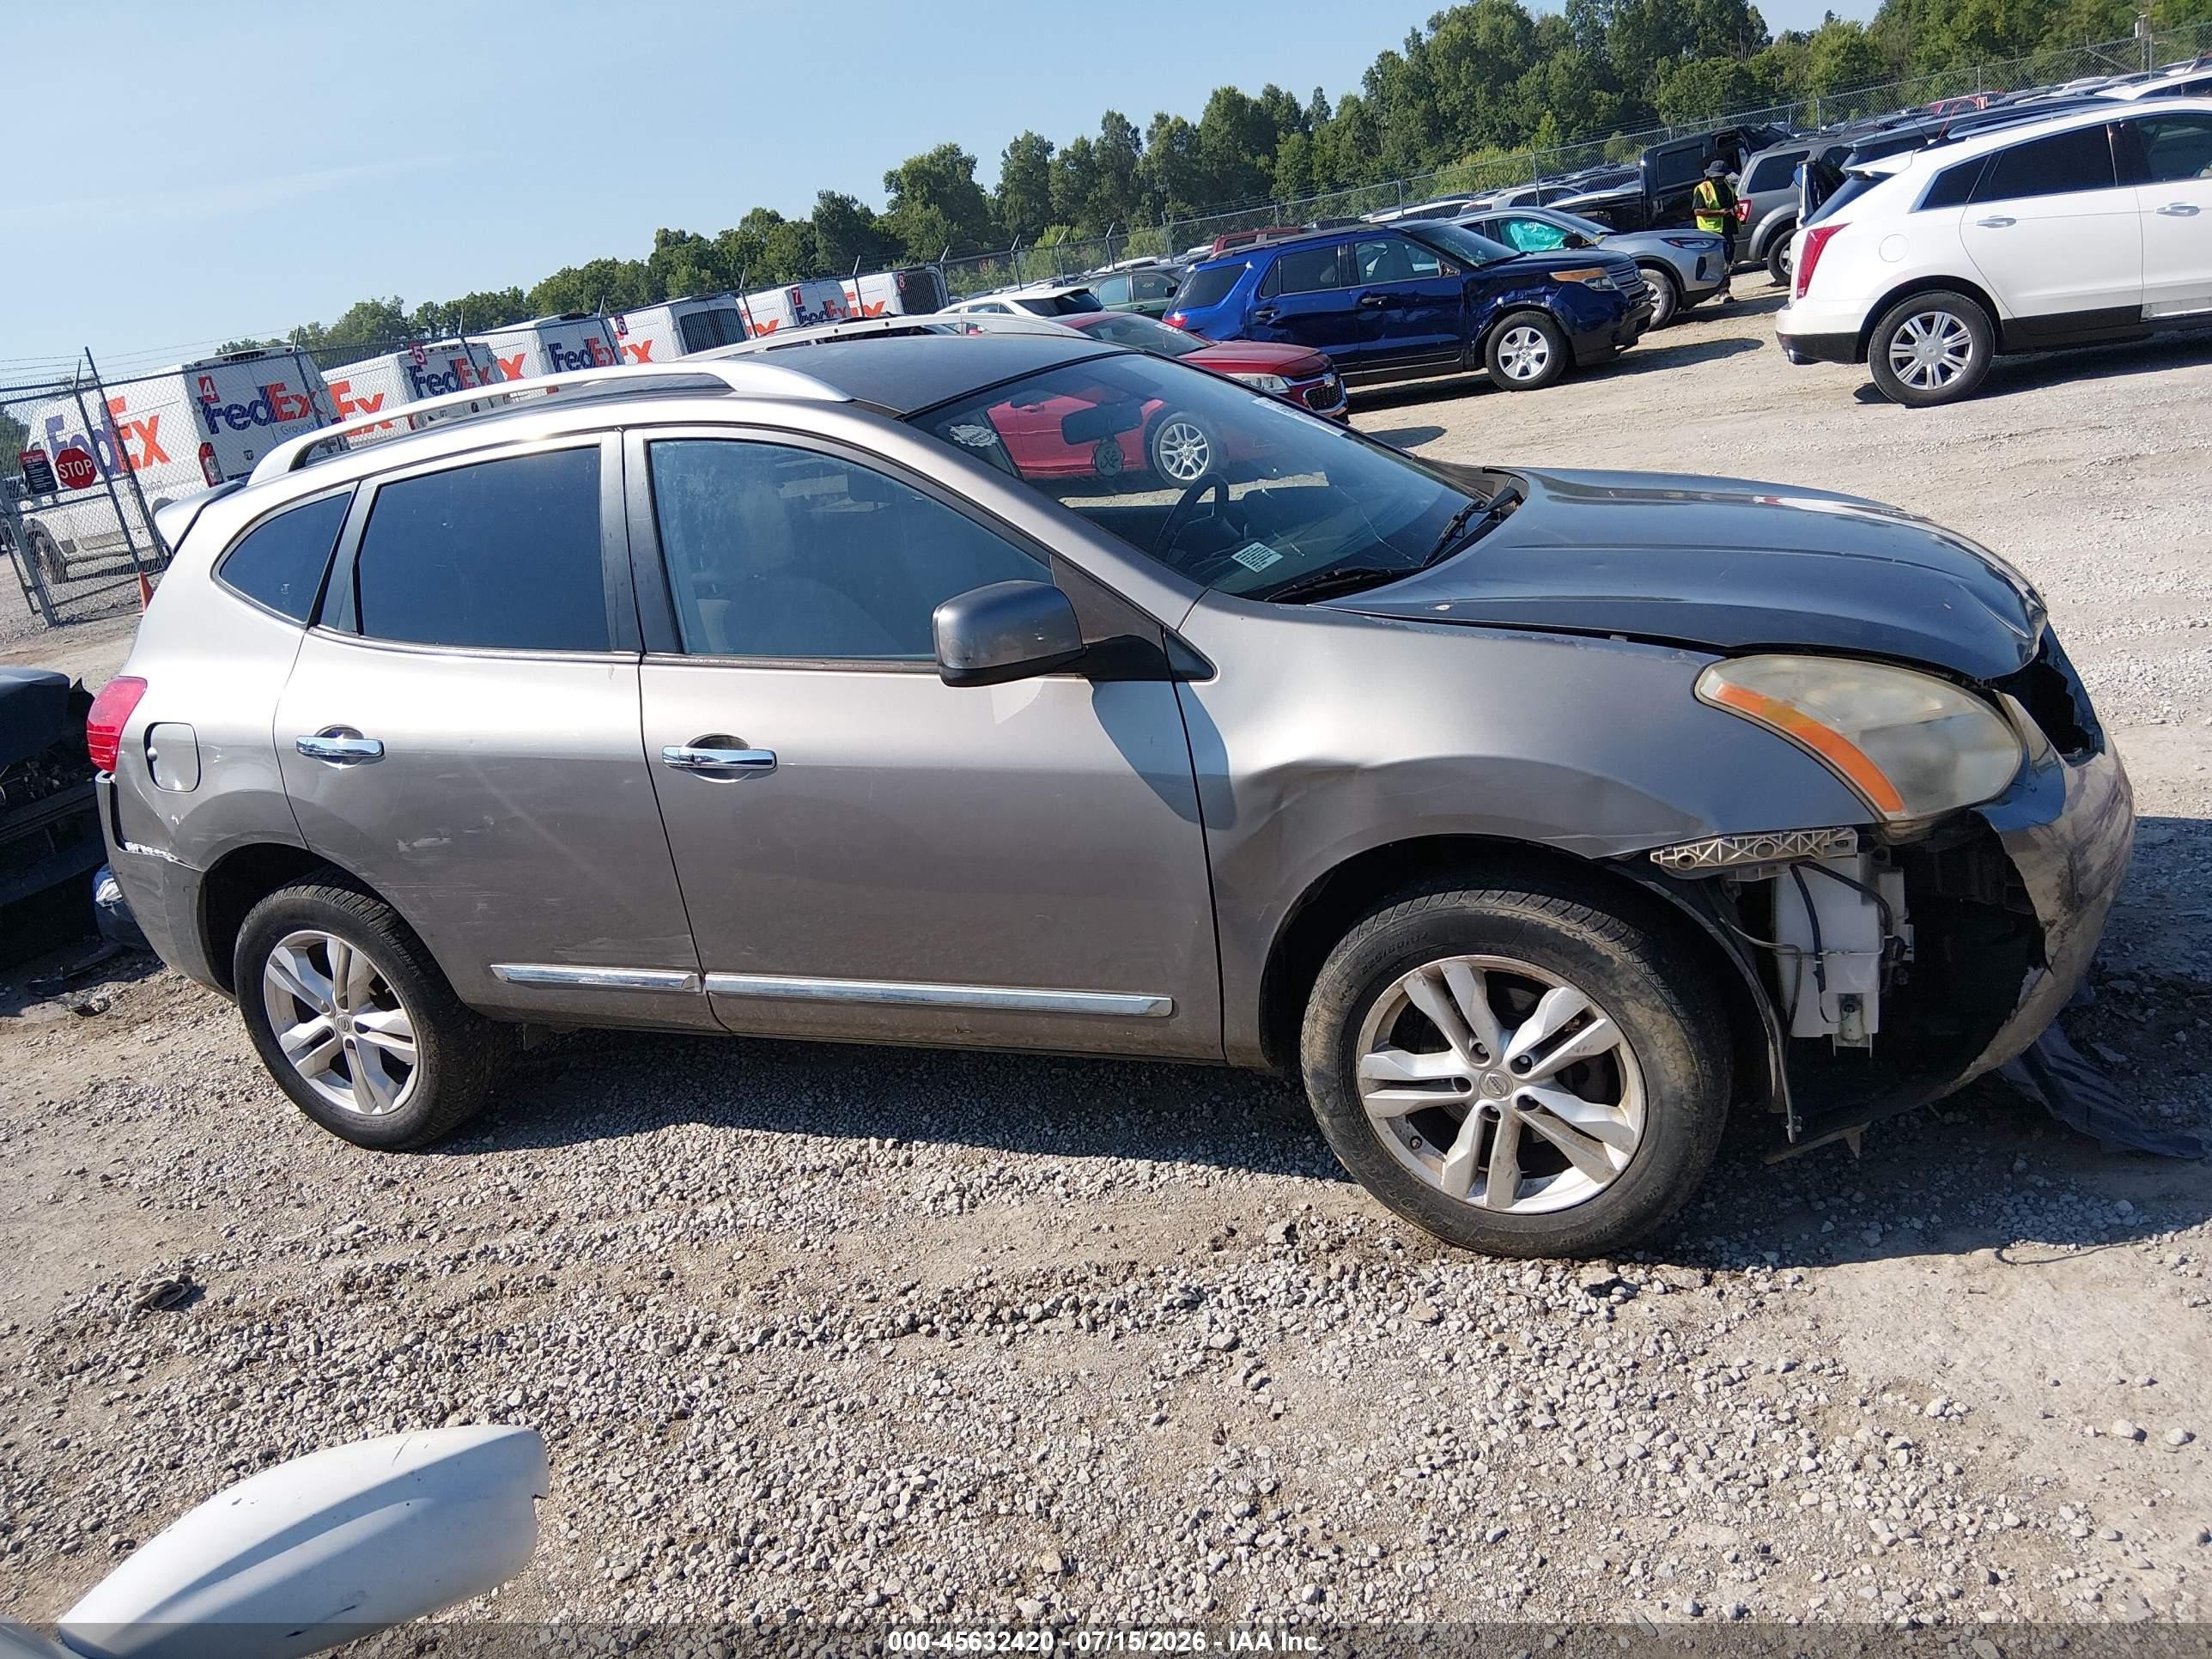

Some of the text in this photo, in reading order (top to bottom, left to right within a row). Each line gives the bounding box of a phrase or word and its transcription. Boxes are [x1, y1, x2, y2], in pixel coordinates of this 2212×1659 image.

[897, 275, 906, 289] 8
[792, 289, 800, 305] 7
[617, 318, 626, 334] 6
[413, 345, 425, 363] 5
[202, 379, 215, 398] 4
[197, 382, 325, 434] FedEx
[58, 459, 93, 479] STOP
